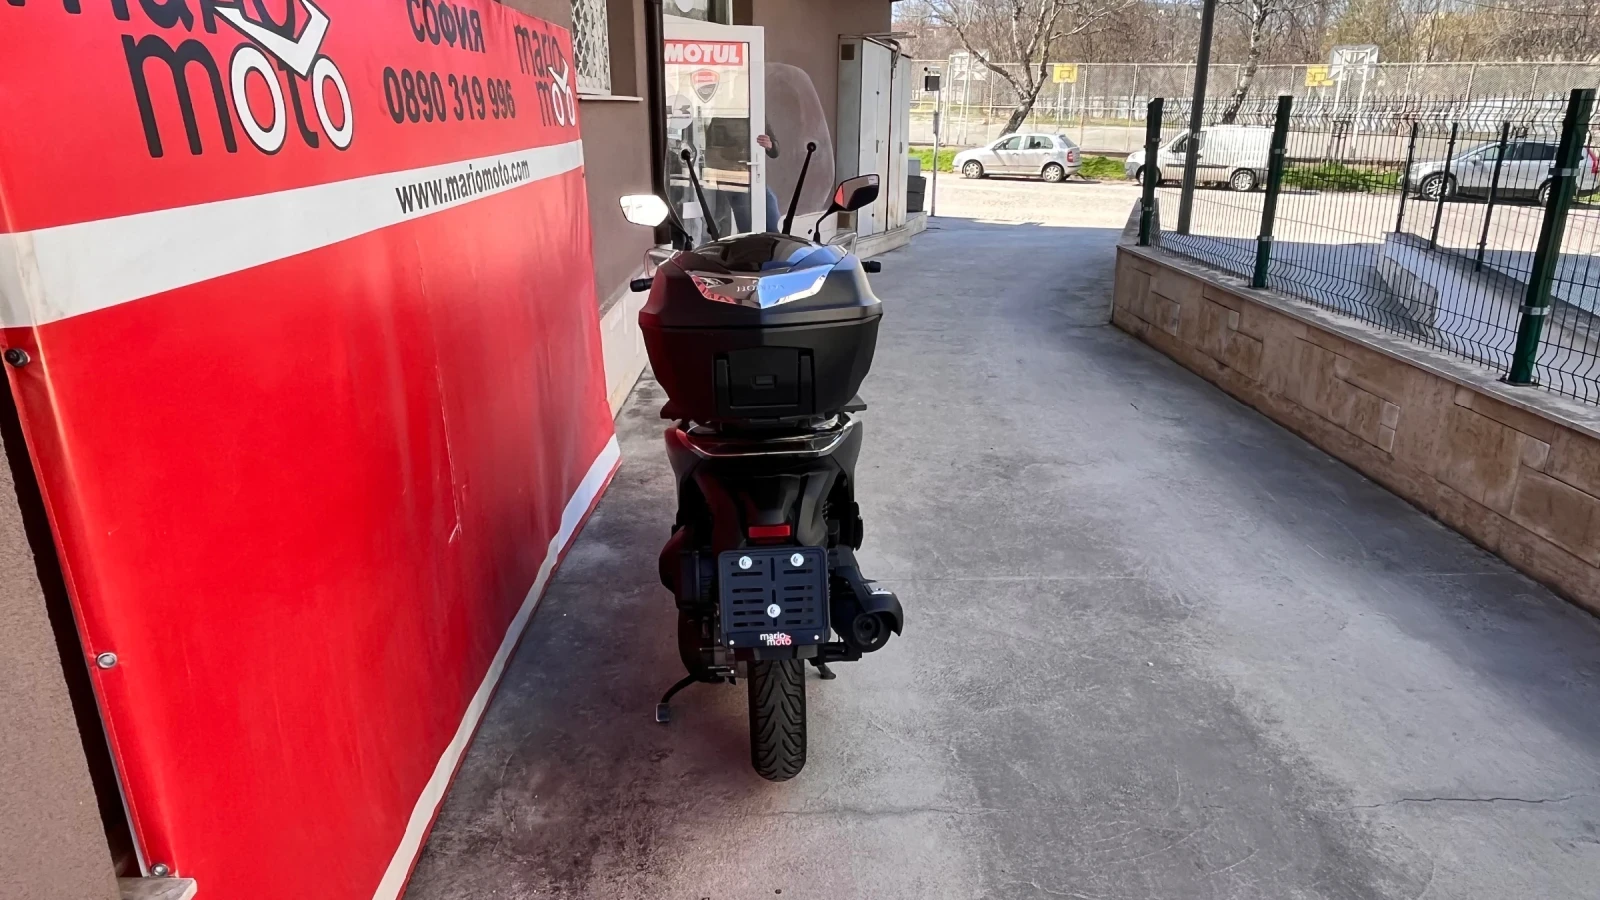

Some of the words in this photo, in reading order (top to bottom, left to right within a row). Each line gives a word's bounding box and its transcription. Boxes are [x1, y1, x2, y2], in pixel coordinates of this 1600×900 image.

[406, 0, 486, 54] СОФИЯ
[514, 22, 567, 78] mario
[664, 43, 740, 64] MOTUL
[121, 33, 354, 158] moto
[383, 66, 447, 124] 0890
[448, 73, 486, 121] 319
[487, 78, 516, 119] 996
[536, 81, 576, 128] moo
[395, 159, 531, 214] www.mariomoto.com
[760, 631, 787, 640] mario
[766, 638, 792, 646] moto
